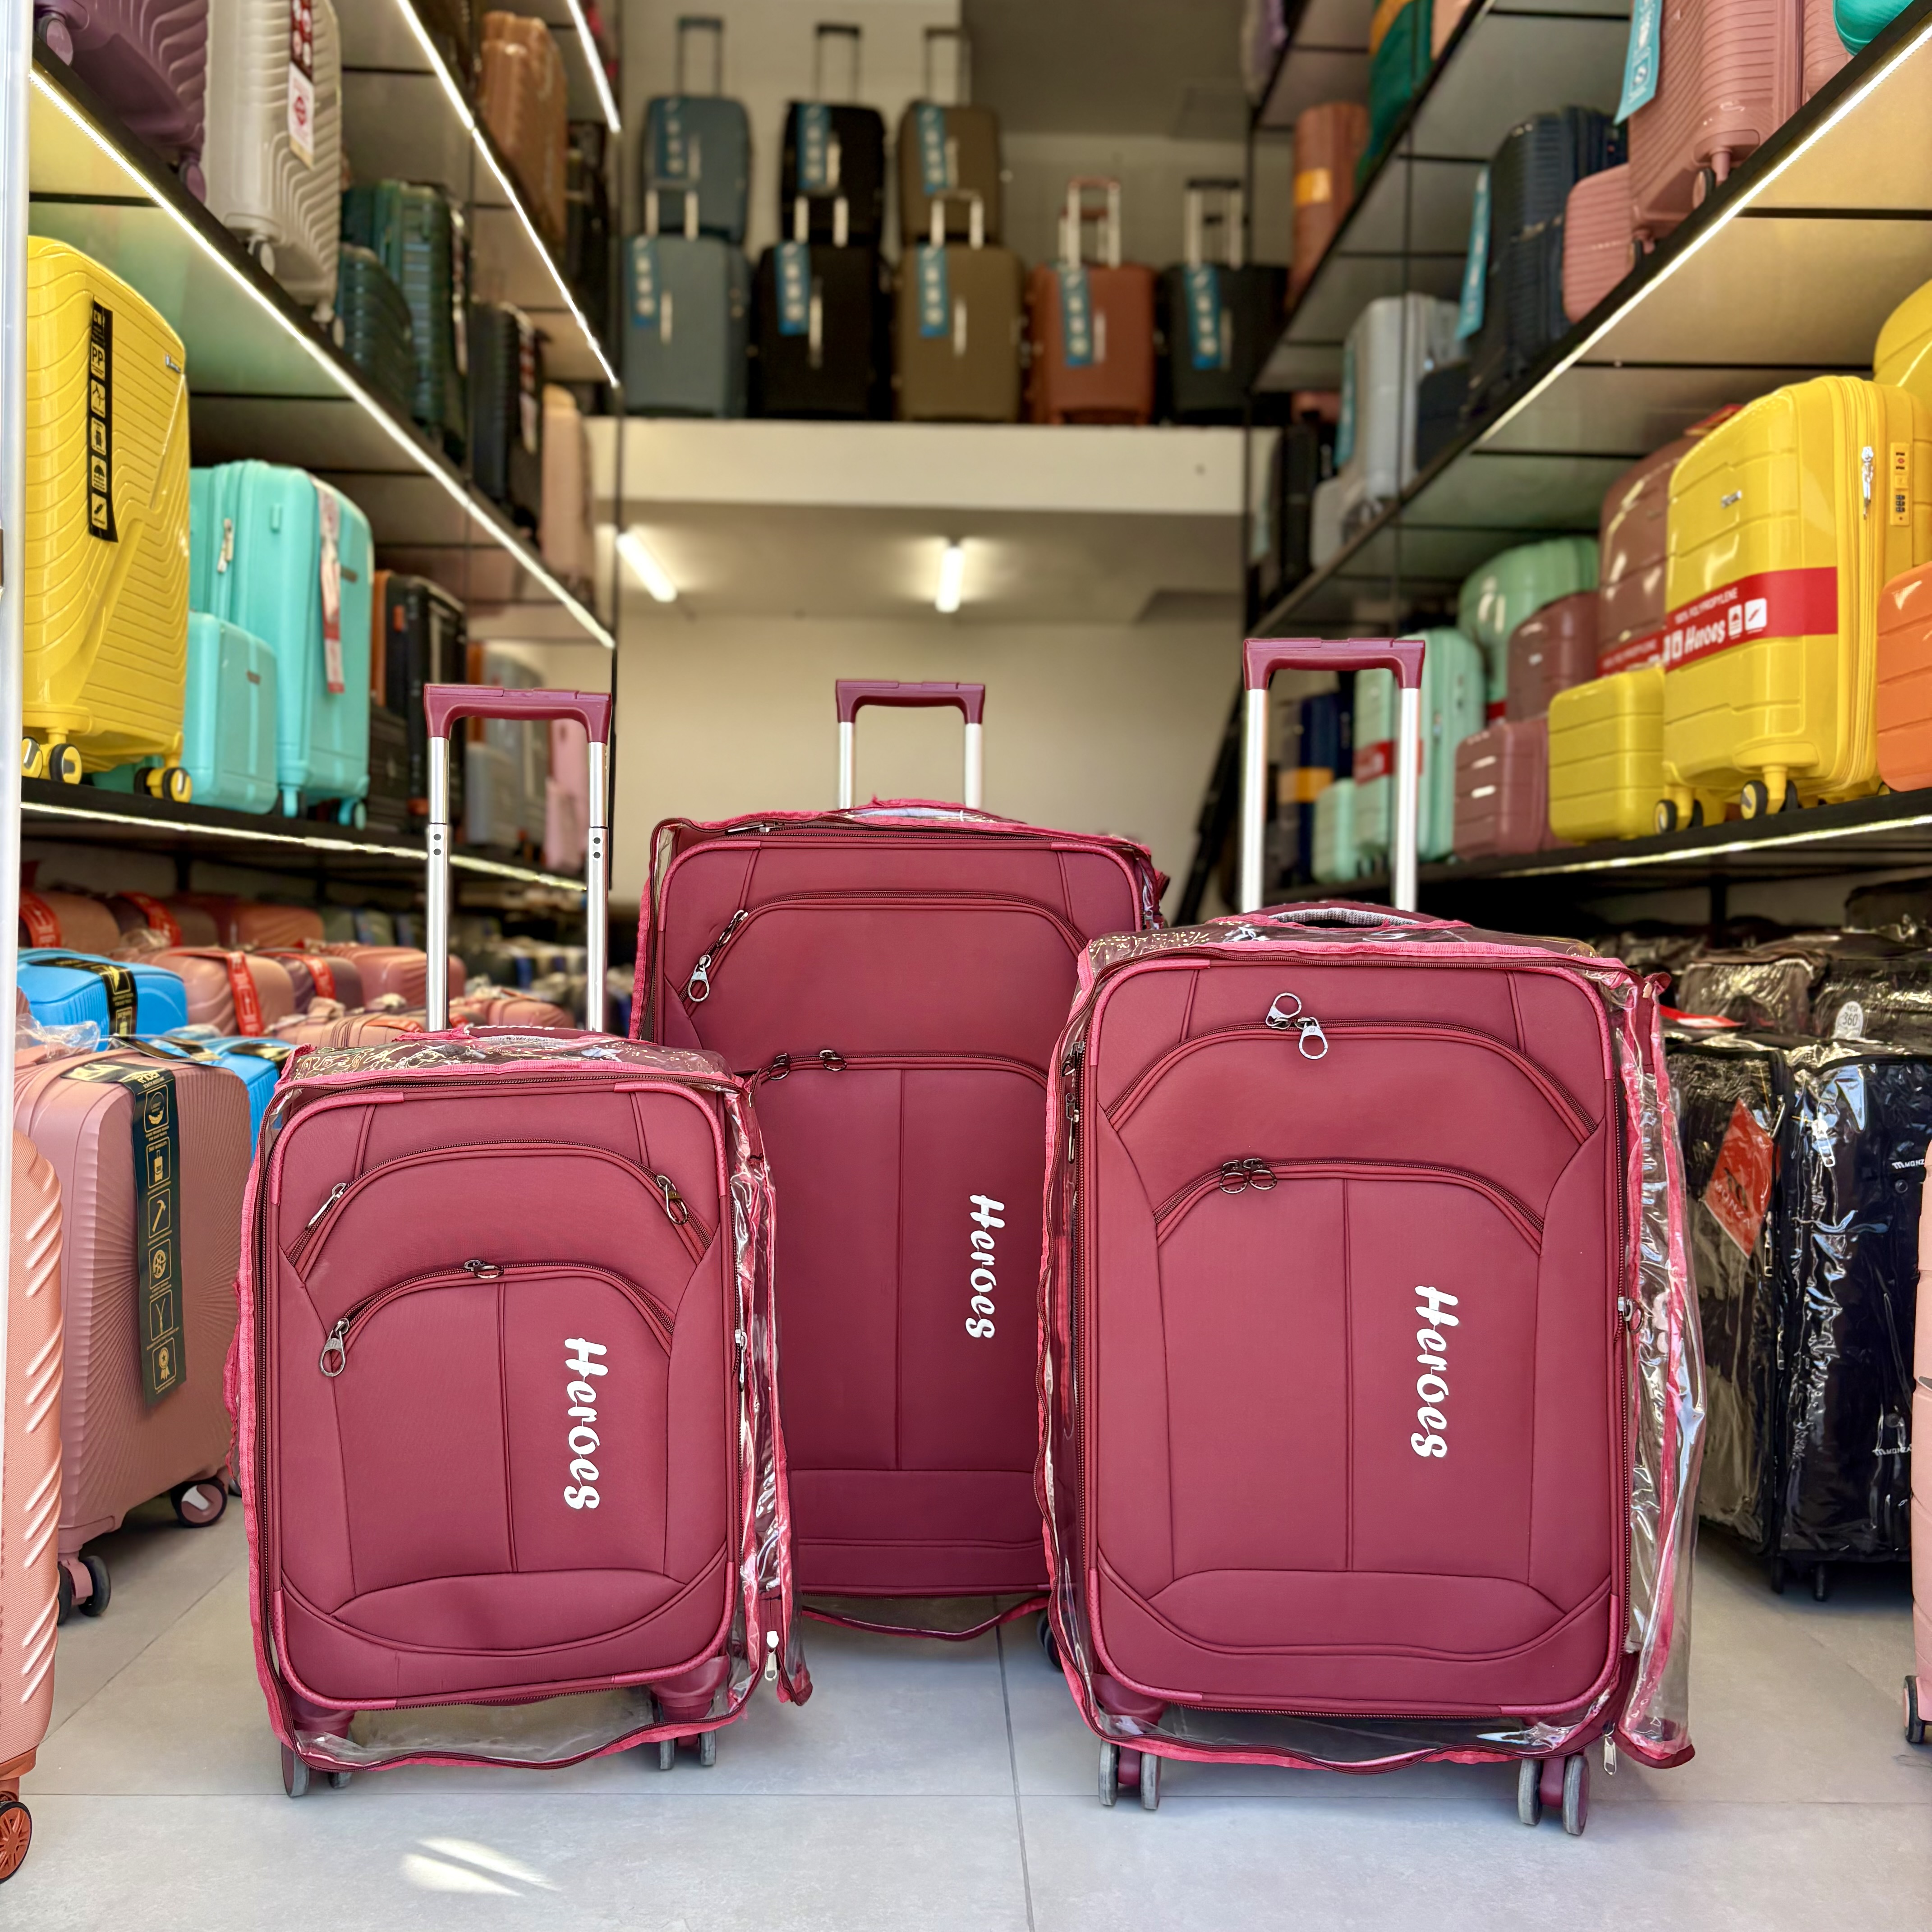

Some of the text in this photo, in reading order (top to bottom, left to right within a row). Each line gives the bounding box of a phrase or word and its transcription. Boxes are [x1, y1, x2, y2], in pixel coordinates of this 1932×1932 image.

[92, 346, 103, 366] PP
[1684, 619, 1725, 654] Heroes
[1842, 1012, 1858, 1026] 360
[1904, 1159, 1925, 1168] MONZ
[966, 1195, 1005, 1338] Heroes
[1410, 1285, 1459, 1458] Heroes
[563, 1338, 608, 1509] Heroes
